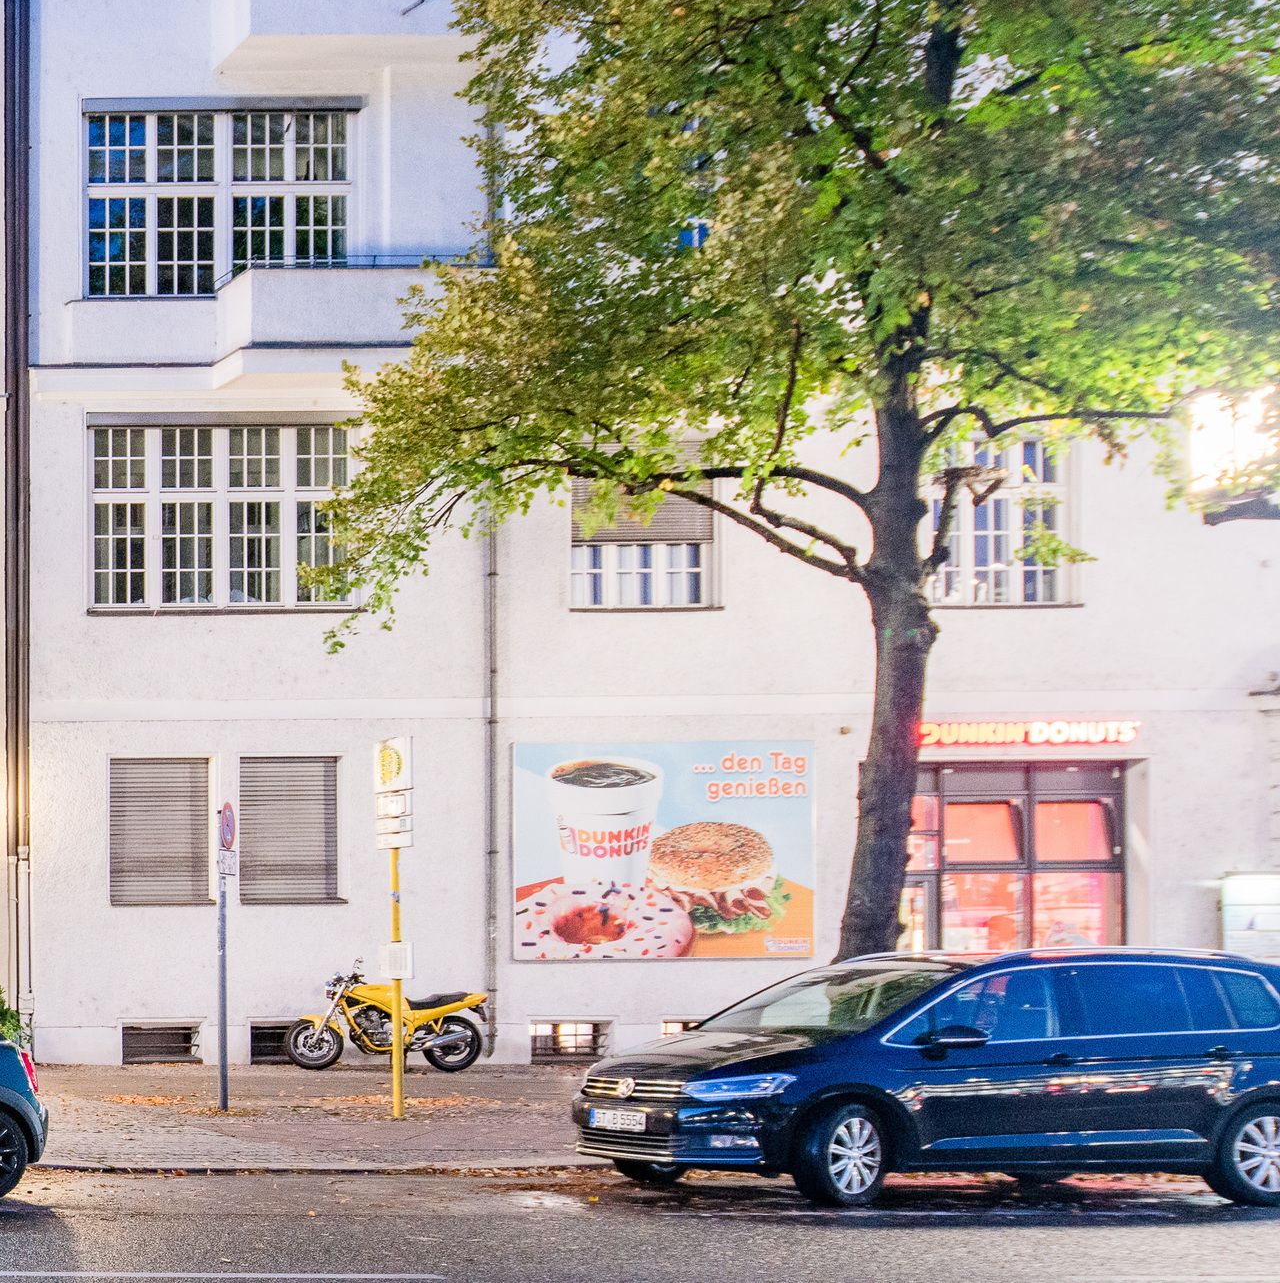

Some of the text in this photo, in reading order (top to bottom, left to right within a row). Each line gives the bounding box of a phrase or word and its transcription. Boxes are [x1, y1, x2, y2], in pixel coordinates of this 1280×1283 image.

[1029, 720, 1138, 743] DONUTS
[722, 752, 761, 772] den
[770, 752, 807, 774] Tag
[707, 778, 807, 800] genießen
[579, 837, 649, 859] DONUTS
